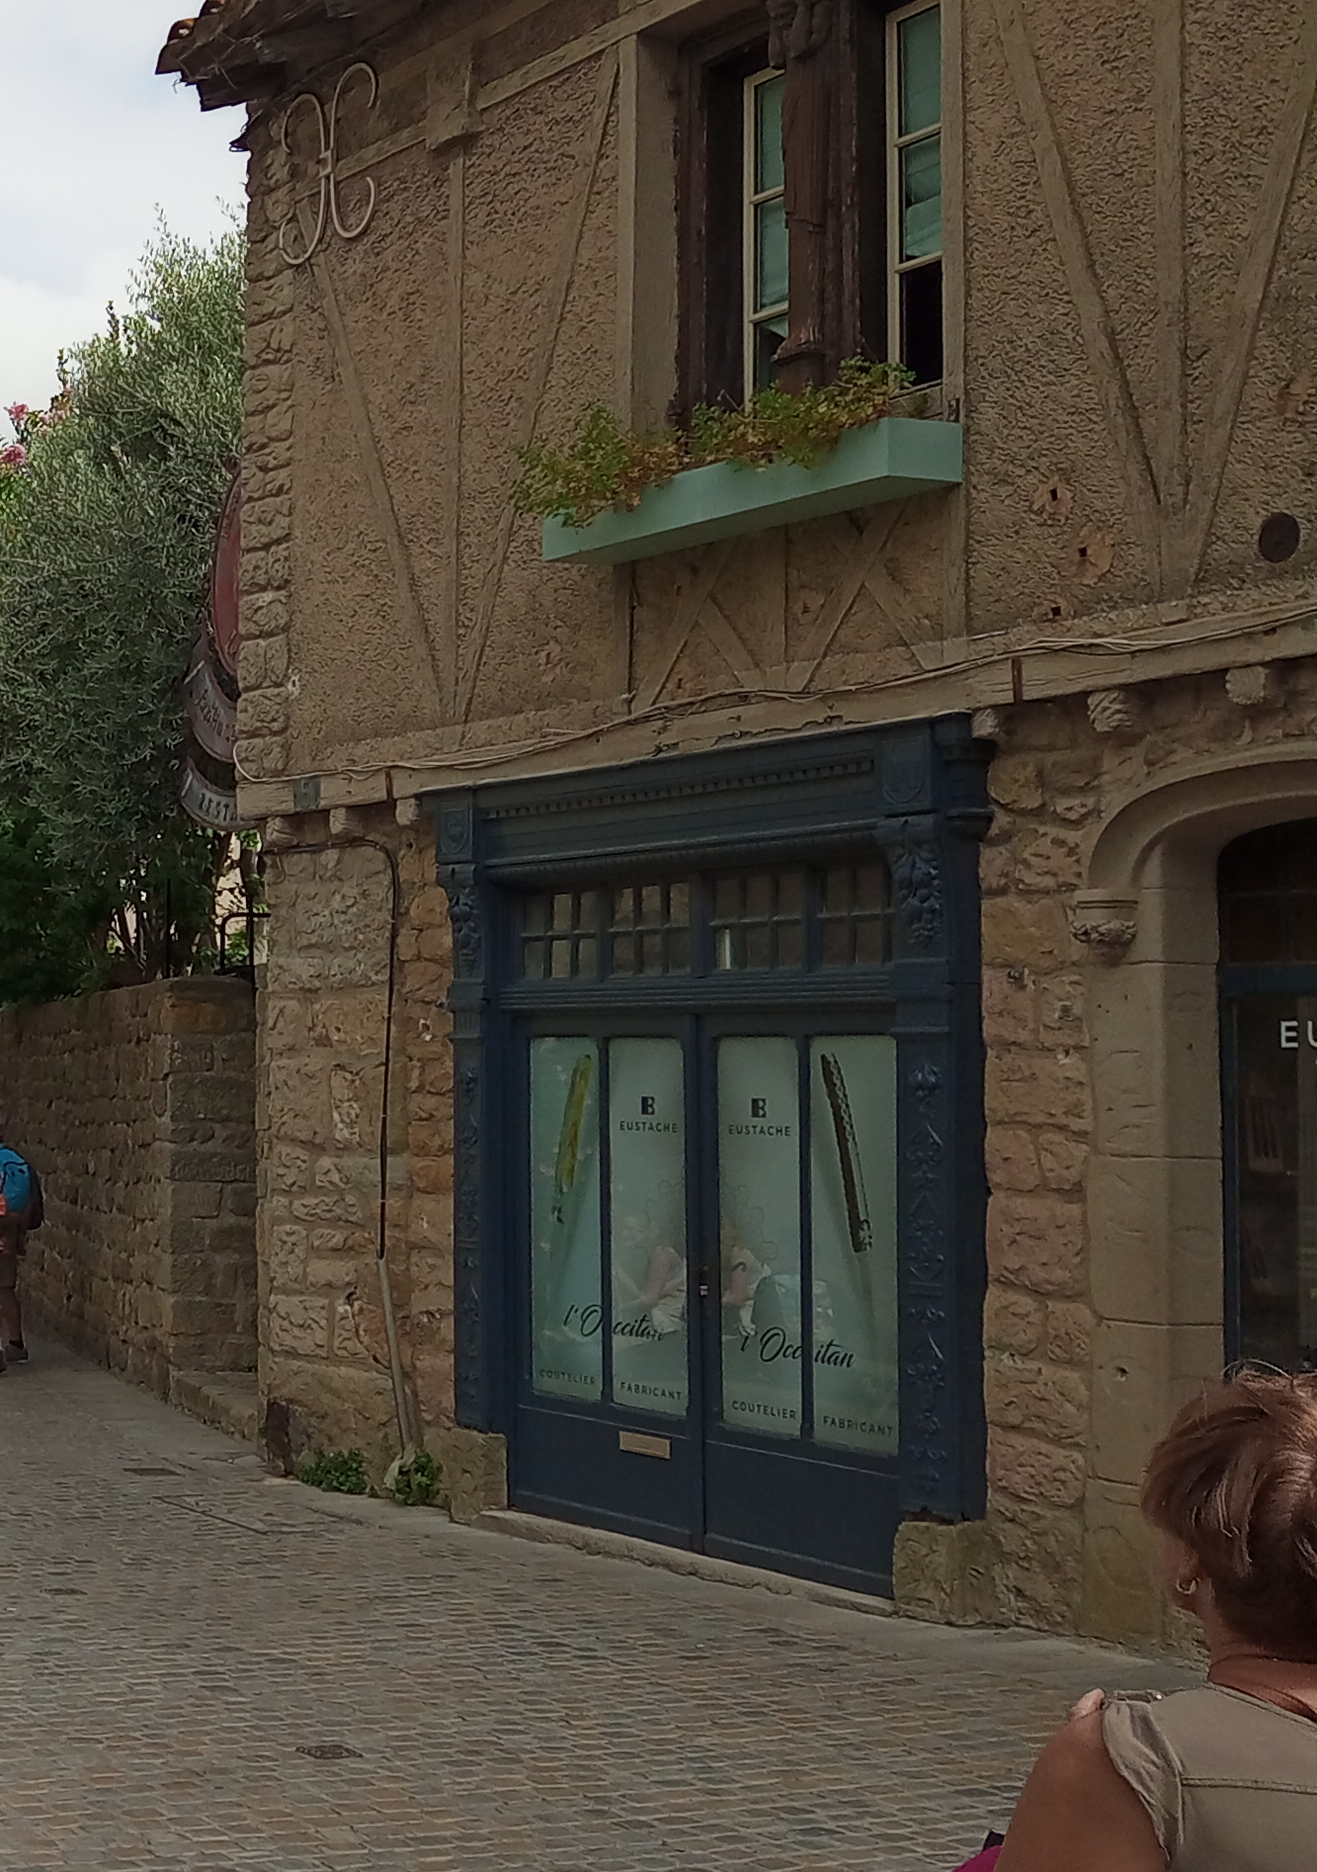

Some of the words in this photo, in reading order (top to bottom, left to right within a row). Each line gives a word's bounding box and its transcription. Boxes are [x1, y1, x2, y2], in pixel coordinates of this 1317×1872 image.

[619, 1120, 678, 1134] EUSTACHE
[728, 1124, 792, 1137] EUSTACHE
[539, 1368, 596, 1386] COUTELIER
[619, 1381, 682, 1401] FABRICANT
[731, 1400, 797, 1420] COUTELIER
[823, 1415, 893, 1437] FABRICANT
